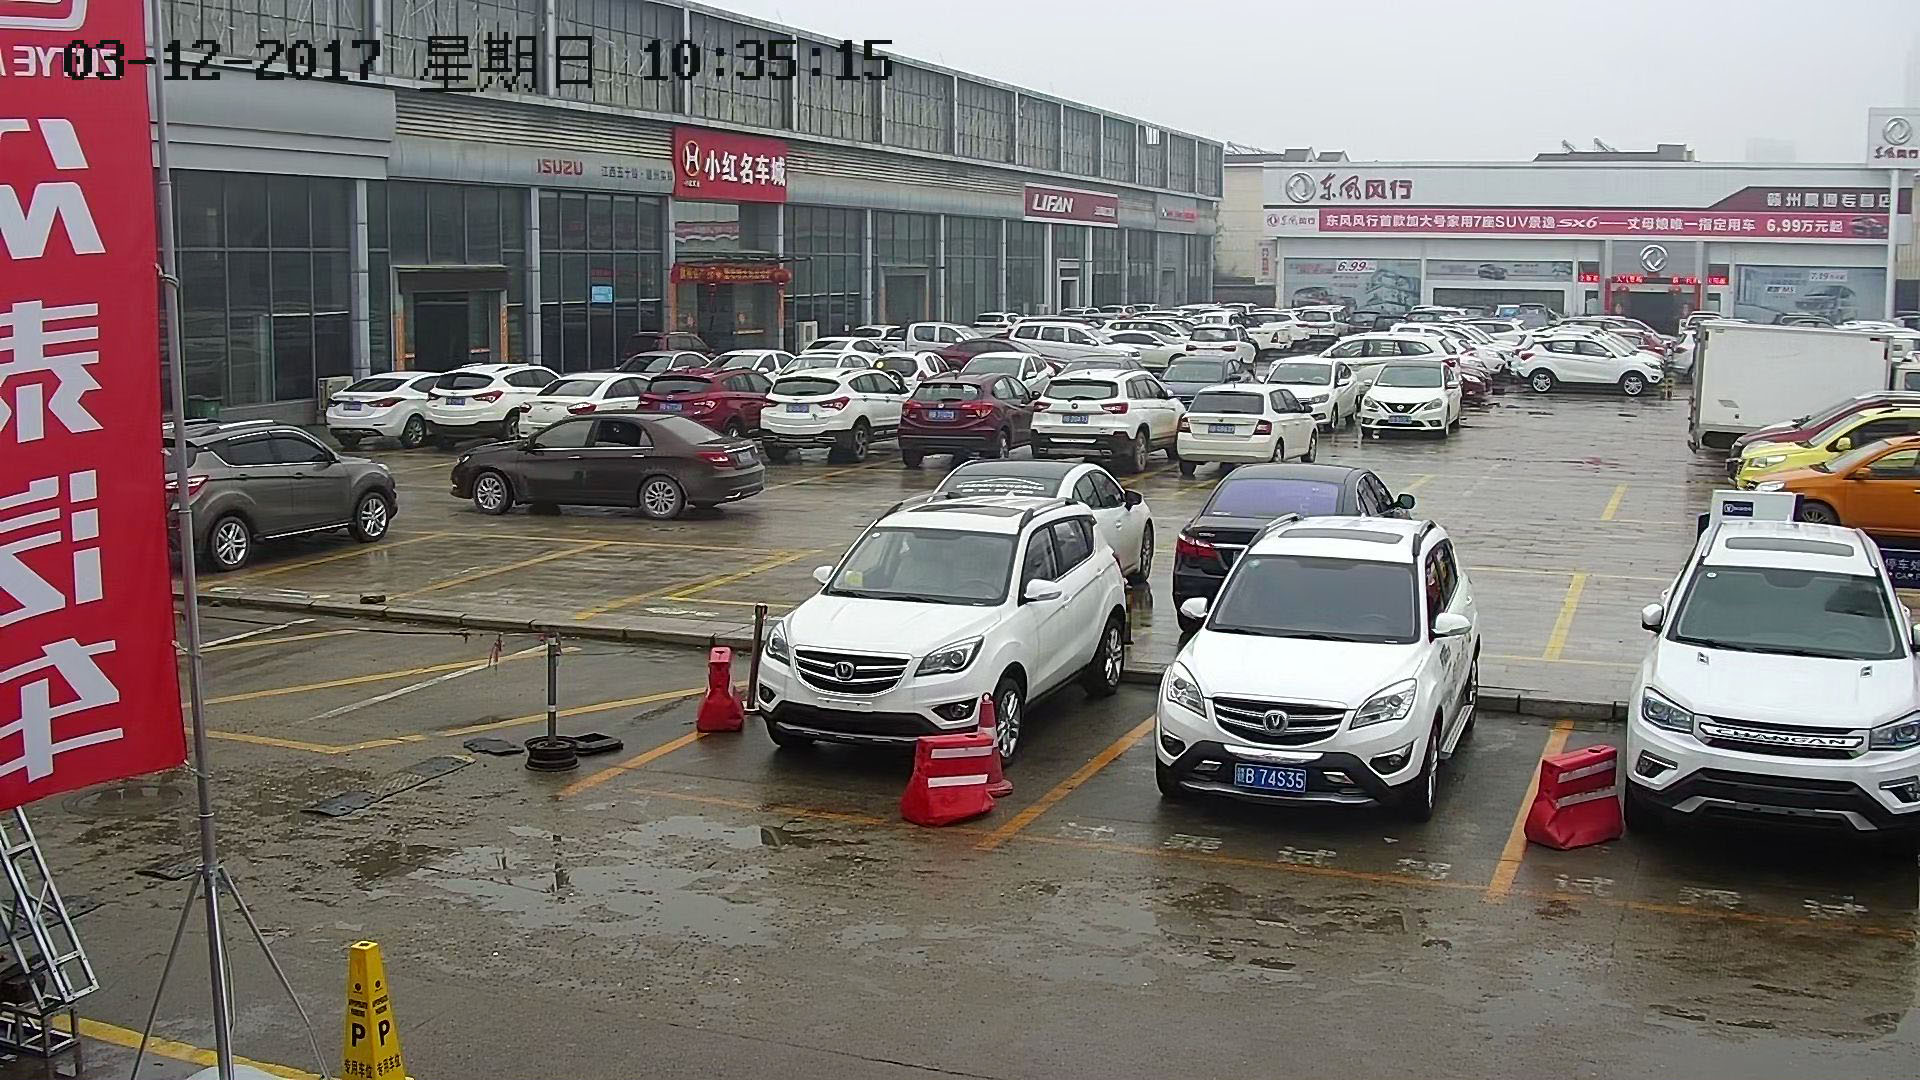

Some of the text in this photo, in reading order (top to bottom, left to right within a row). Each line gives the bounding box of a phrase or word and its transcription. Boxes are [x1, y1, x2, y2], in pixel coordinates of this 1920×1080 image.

[537, 158, 584, 175] ISUZU
[703, 150, 786, 187] 小红名车城
[1032, 193, 1074, 213] LIFAN
[1766, 218, 1844, 234] 6.99万元起
[1337, 260, 1367, 272] 6.99
[1716, 727, 1846, 746] CHANGAN
[351, 1022, 366, 1048] P
[378, 1019, 391, 1048] P
